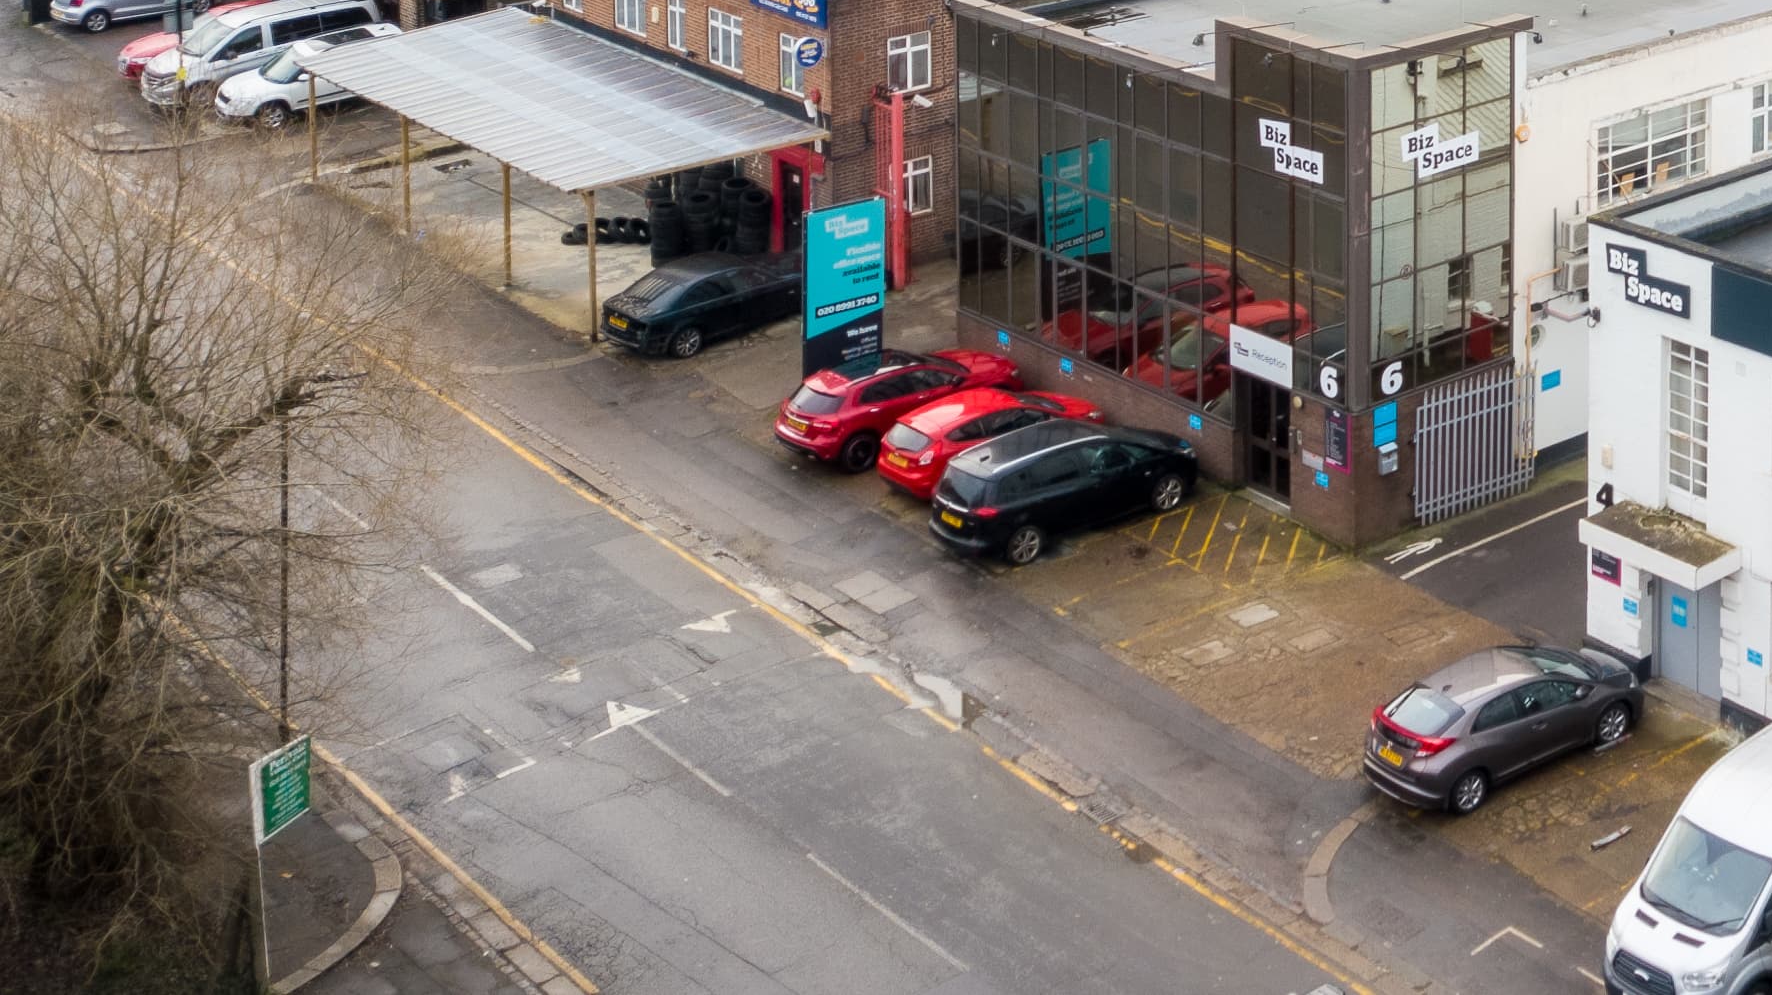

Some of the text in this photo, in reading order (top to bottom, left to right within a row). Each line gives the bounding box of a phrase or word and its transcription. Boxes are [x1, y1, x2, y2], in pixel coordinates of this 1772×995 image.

[1265, 125, 1287, 145] Biz
[1408, 135, 1434, 154] Biz
[1276, 148, 1318, 175] Space
[1422, 144, 1473, 169] Space
[1609, 248, 1639, 276] Biz
[1627, 276, 1683, 312] Space
[1252, 348, 1288, 371] Reception
[1320, 366, 1338, 399] 6
[1381, 360, 1403, 395] 6
[1596, 482, 1613, 509] 4
